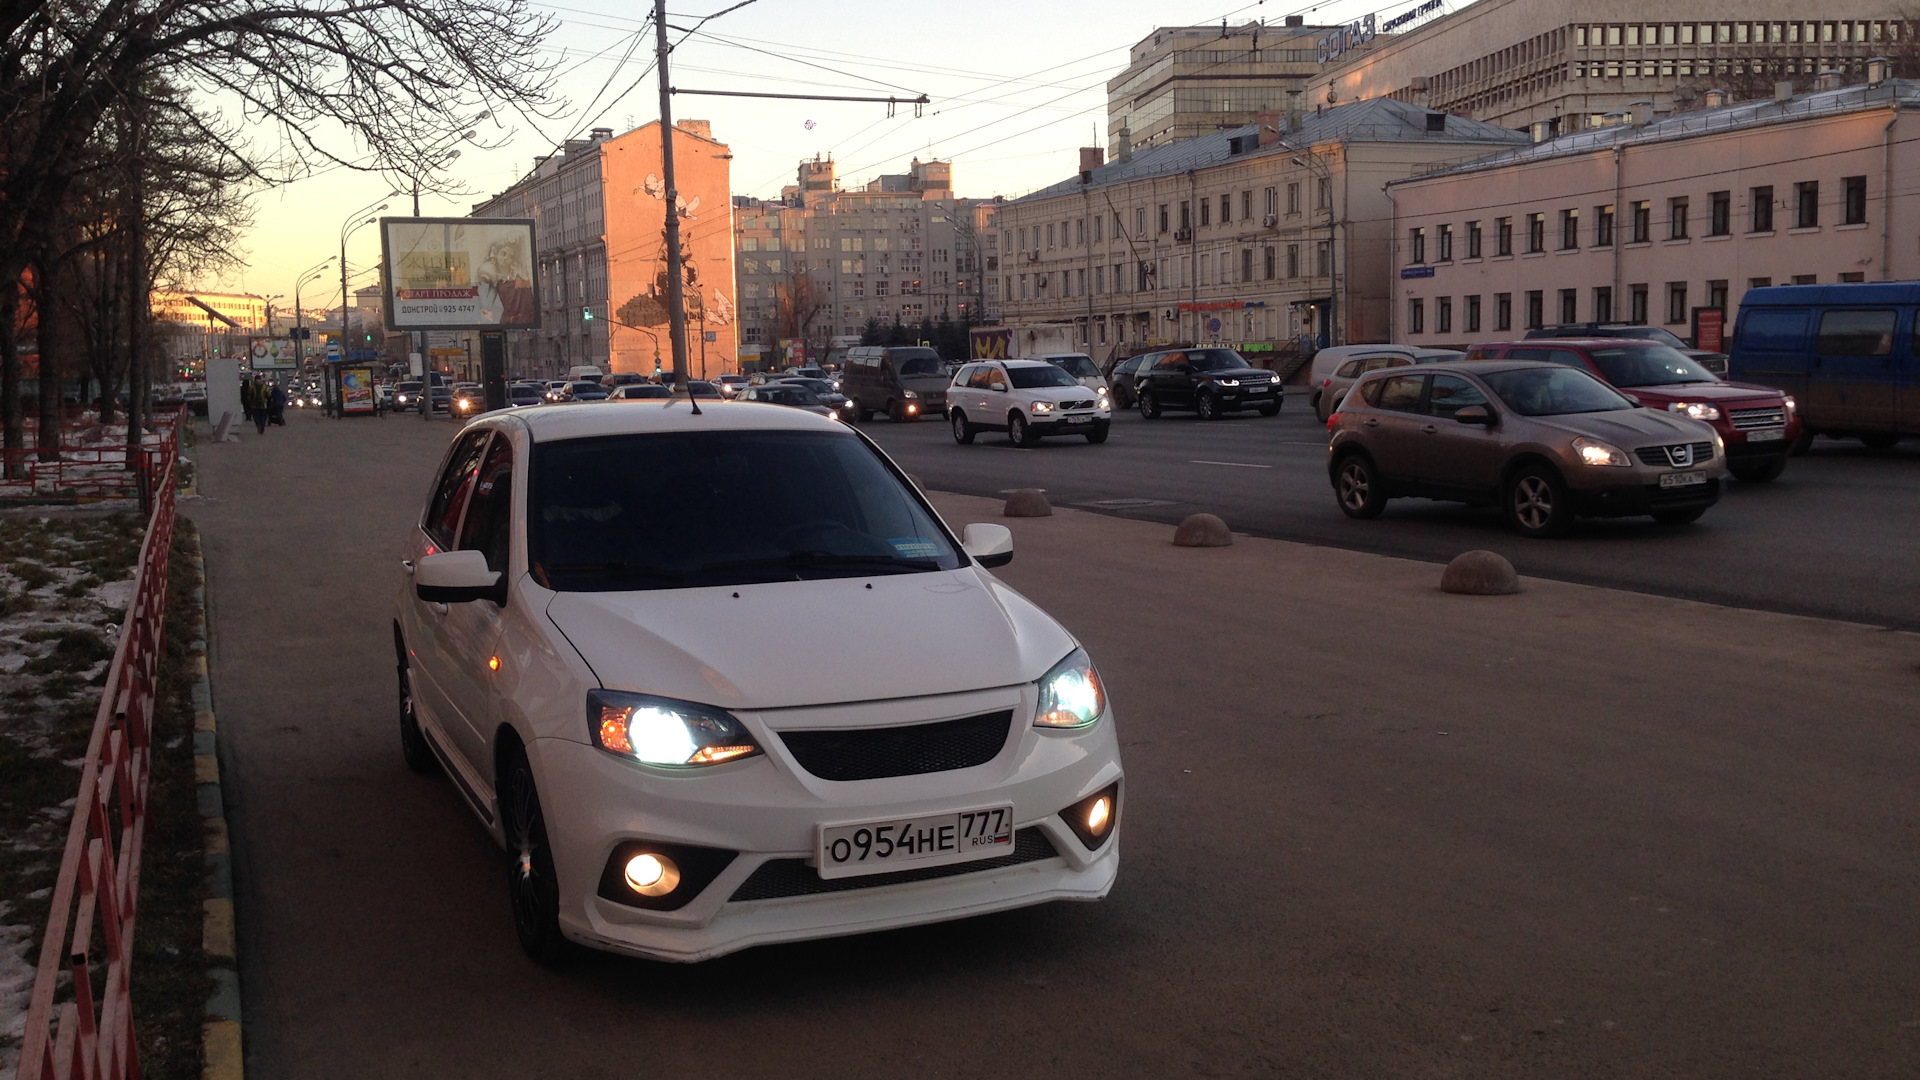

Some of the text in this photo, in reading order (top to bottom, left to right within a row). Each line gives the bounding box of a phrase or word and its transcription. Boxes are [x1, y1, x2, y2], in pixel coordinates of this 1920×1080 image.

[1317, 13, 1375, 64] СОГАЗ
[406, 256, 466, 269] ЖИЗНЬ
[404, 290, 471, 298] СТАРТ ПРОДАЖ
[402, 304, 438, 314] ДОНСТРОЙ
[444, 305, 457, 313] 925
[458, 305, 475, 313] 4747
[962, 809, 1005, 838] 777
[972, 835, 994, 846] RUS
